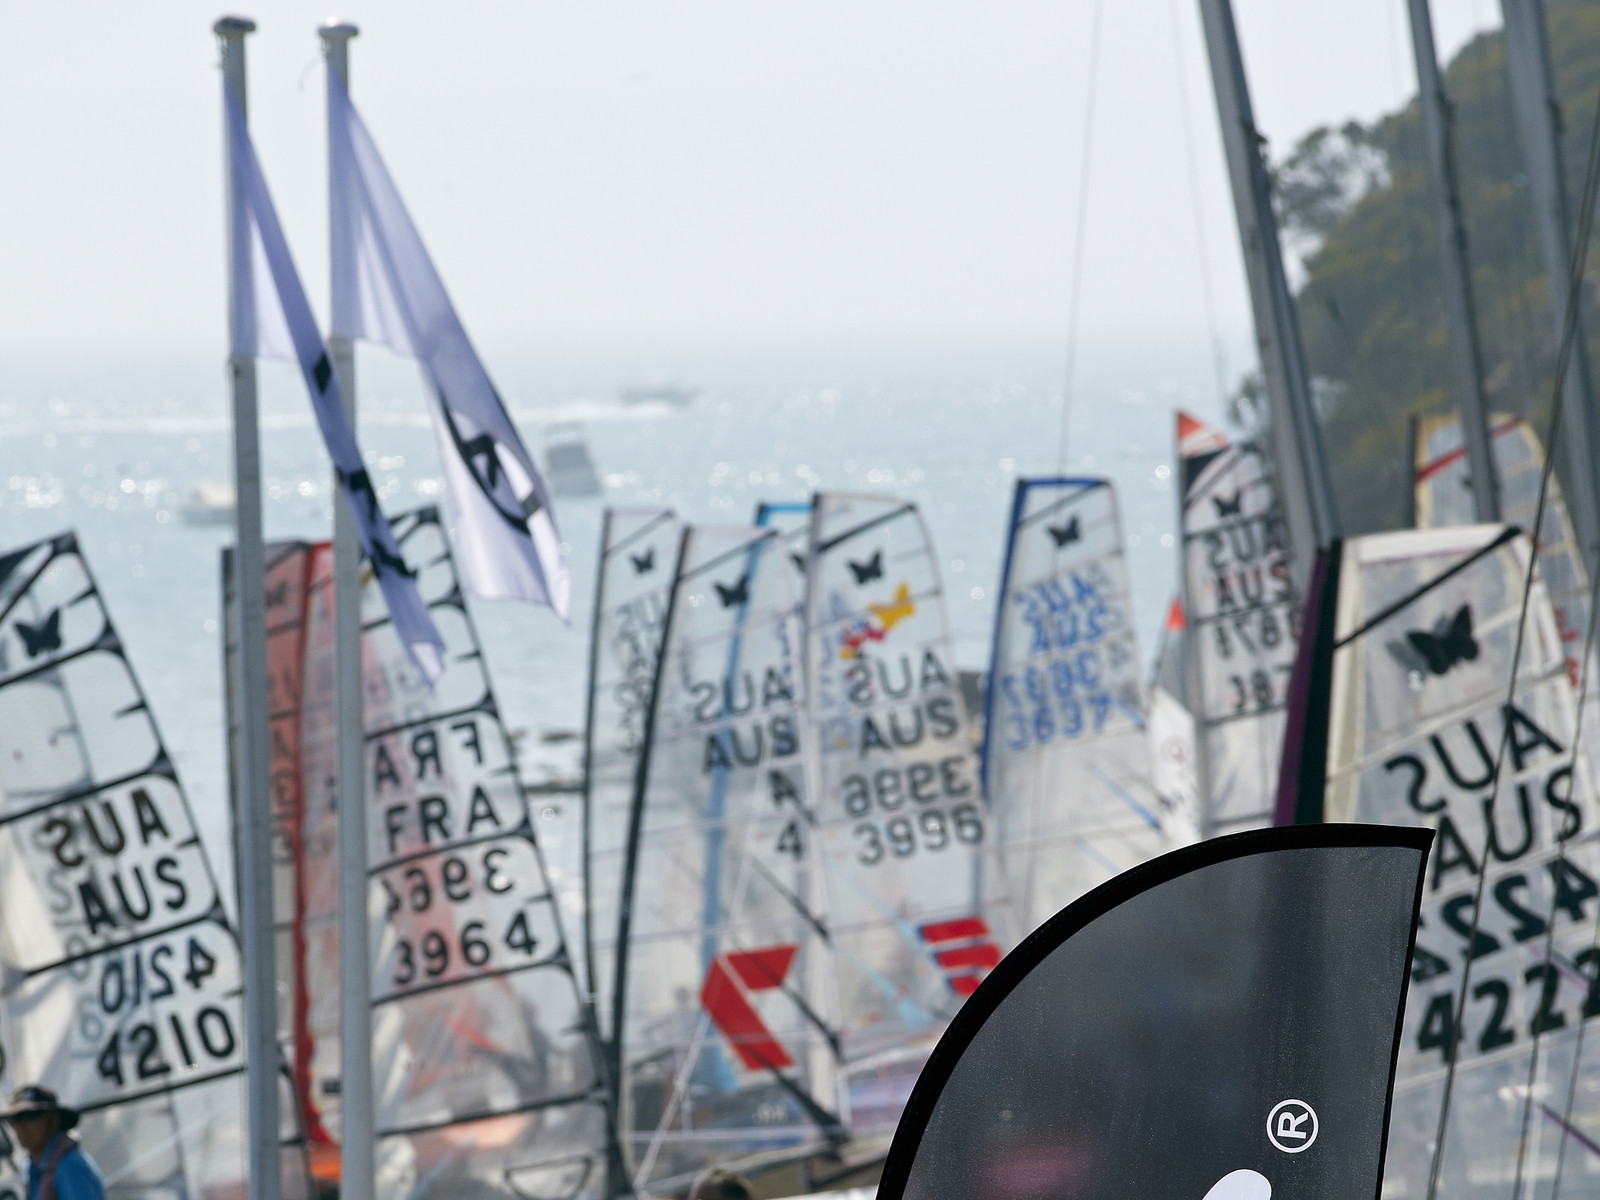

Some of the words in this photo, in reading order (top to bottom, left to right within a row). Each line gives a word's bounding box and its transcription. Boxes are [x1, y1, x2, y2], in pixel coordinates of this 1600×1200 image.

[703, 716, 800, 790] AUS
[858, 695, 960, 758] AUS
[385, 784, 502, 853] FRA
[853, 802, 985, 867] 3996
[1430, 765, 1582, 890] AUS
[78, 855, 188, 936] AUS
[393, 909, 539, 986] 3964
[97, 1005, 236, 1087] 4210
